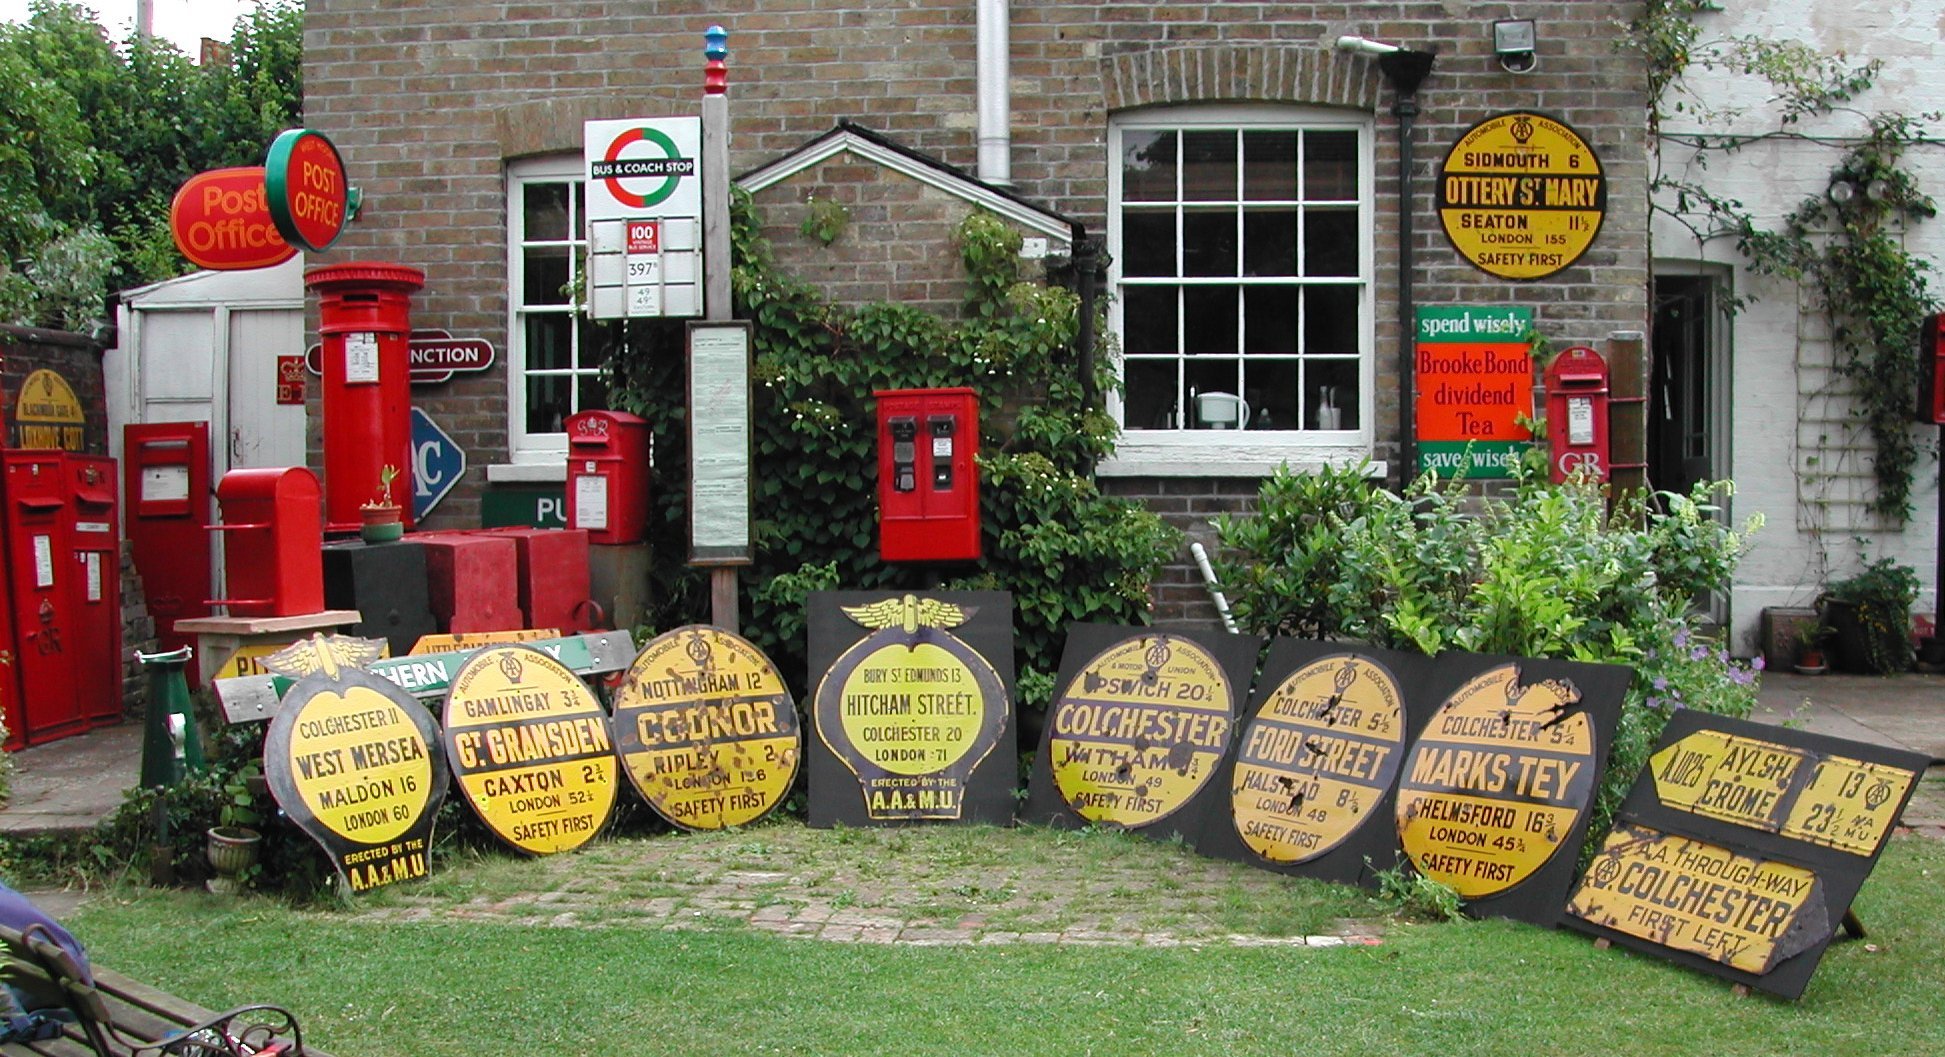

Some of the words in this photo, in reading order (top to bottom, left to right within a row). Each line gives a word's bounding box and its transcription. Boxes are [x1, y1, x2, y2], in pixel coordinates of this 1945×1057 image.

[1465, 119, 1506, 147] AUTOMOBILE
[1538, 120, 1582, 150] ASSOCIATION
[592, 164, 613, 176] BUS
[615, 164, 623, 174] &
[624, 162, 664, 174] COACH
[666, 162, 694, 172] STOP
[1464, 153, 1549, 168] SIDMOUTH
[1569, 155, 1580, 169] 6
[303, 160, 336, 195] POST
[203, 182, 268, 217] Post
[1446, 177, 1517, 206] OTTERY
[1545, 178, 1599, 207] MARY
[295, 191, 339, 228] OFFICE
[1461, 213, 1529, 230] SEATON
[188, 218, 285, 251] Office
[631, 225, 654, 240] 100
[1481, 233, 1533, 244] LONDON
[1545, 234, 1567, 245] 155
[1478, 253, 1525, 266] SAFETY
[1529, 253, 1563, 267] FIRST
[1421, 312, 1470, 337] spend
[1473, 312, 1526, 337] wisely
[1420, 351, 1483, 374] Brooke
[1484, 351, 1529, 374] Bond
[1434, 382, 1515, 406] dividend
[1455, 411, 1494, 435] Tea
[1423, 452, 1462, 468] save
[1558, 452, 1605, 476] GR
[459, 656, 494, 693] AUTOMOBILE
[524, 654, 573, 684] ASSOCIATION
[863, 668, 888, 684] BURY
[904, 668, 949, 684] EDMUNDS
[951, 668, 962, 683] 13
[1167, 666, 1197, 675] UNION
[641, 672, 741, 700] NOTTINGHAM
[746, 671, 763, 690] 12
[1363, 668, 1394, 707] ASSOCIATION
[1452, 673, 1505, 710] AUTOMOBILE
[464, 692, 552, 718] GAMLINGAY
[847, 694, 912, 717] HITCHAM
[300, 709, 386, 739] COLCHESTER
[863, 727, 941, 742] COLCHESTER
[945, 727, 963, 742] 20
[1055, 703, 1228, 747] COLCHESTER
[1441, 716, 1543, 742] COLCHESTER
[486, 717, 611, 765] GRANSDEN
[1245, 725, 1302, 764] FORD
[1300, 734, 1391, 781] STREET
[296, 749, 346, 780] WEST
[351, 736, 423, 771] MERSEA
[653, 750, 720, 775] RIPLEY
[875, 749, 926, 762] LONDON
[1065, 746, 1171, 771] WITHAM
[484, 769, 564, 798] CAXTON
[871, 778, 919, 788] ERECTED
[920, 778, 935, 788] BY
[937, 778, 957, 788] THE
[1146, 776, 1163, 788] 49
[1410, 747, 1508, 793] MARKS
[1515, 756, 1581, 800] TEY
[1838, 770, 1867, 799] 13
[319, 779, 395, 810] MALDON
[401, 775, 417, 794] 16
[509, 794, 561, 814] LONDON
[674, 796, 725, 818] SAFETY
[729, 791, 767, 811] FIRST
[1125, 798, 1164, 814] FIRST
[343, 810, 389, 832] LONDON
[393, 804, 409, 820] 60
[1306, 809, 1328, 823] 48
[1412, 797, 1517, 830] CHELMSFORD
[513, 819, 559, 842] SAFETY
[562, 814, 595, 834] FIRST
[1244, 820, 1286, 843] SAFETY
[1287, 829, 1322, 850] FIRST
[1429, 826, 1487, 847] LONDON
[344, 848, 389, 865] ERECTED
[391, 844, 403, 854] BY
[406, 838, 423, 850] THE
[1421, 853, 1472, 876] SAFETY
[1474, 861, 1515, 882] FIRST
[1673, 847, 1809, 898] THROUGH-WAY
[1617, 861, 1793, 938] COLCHESTER
[1628, 904, 1691, 937] FIRST
[1692, 924, 1747, 956] LEFT
